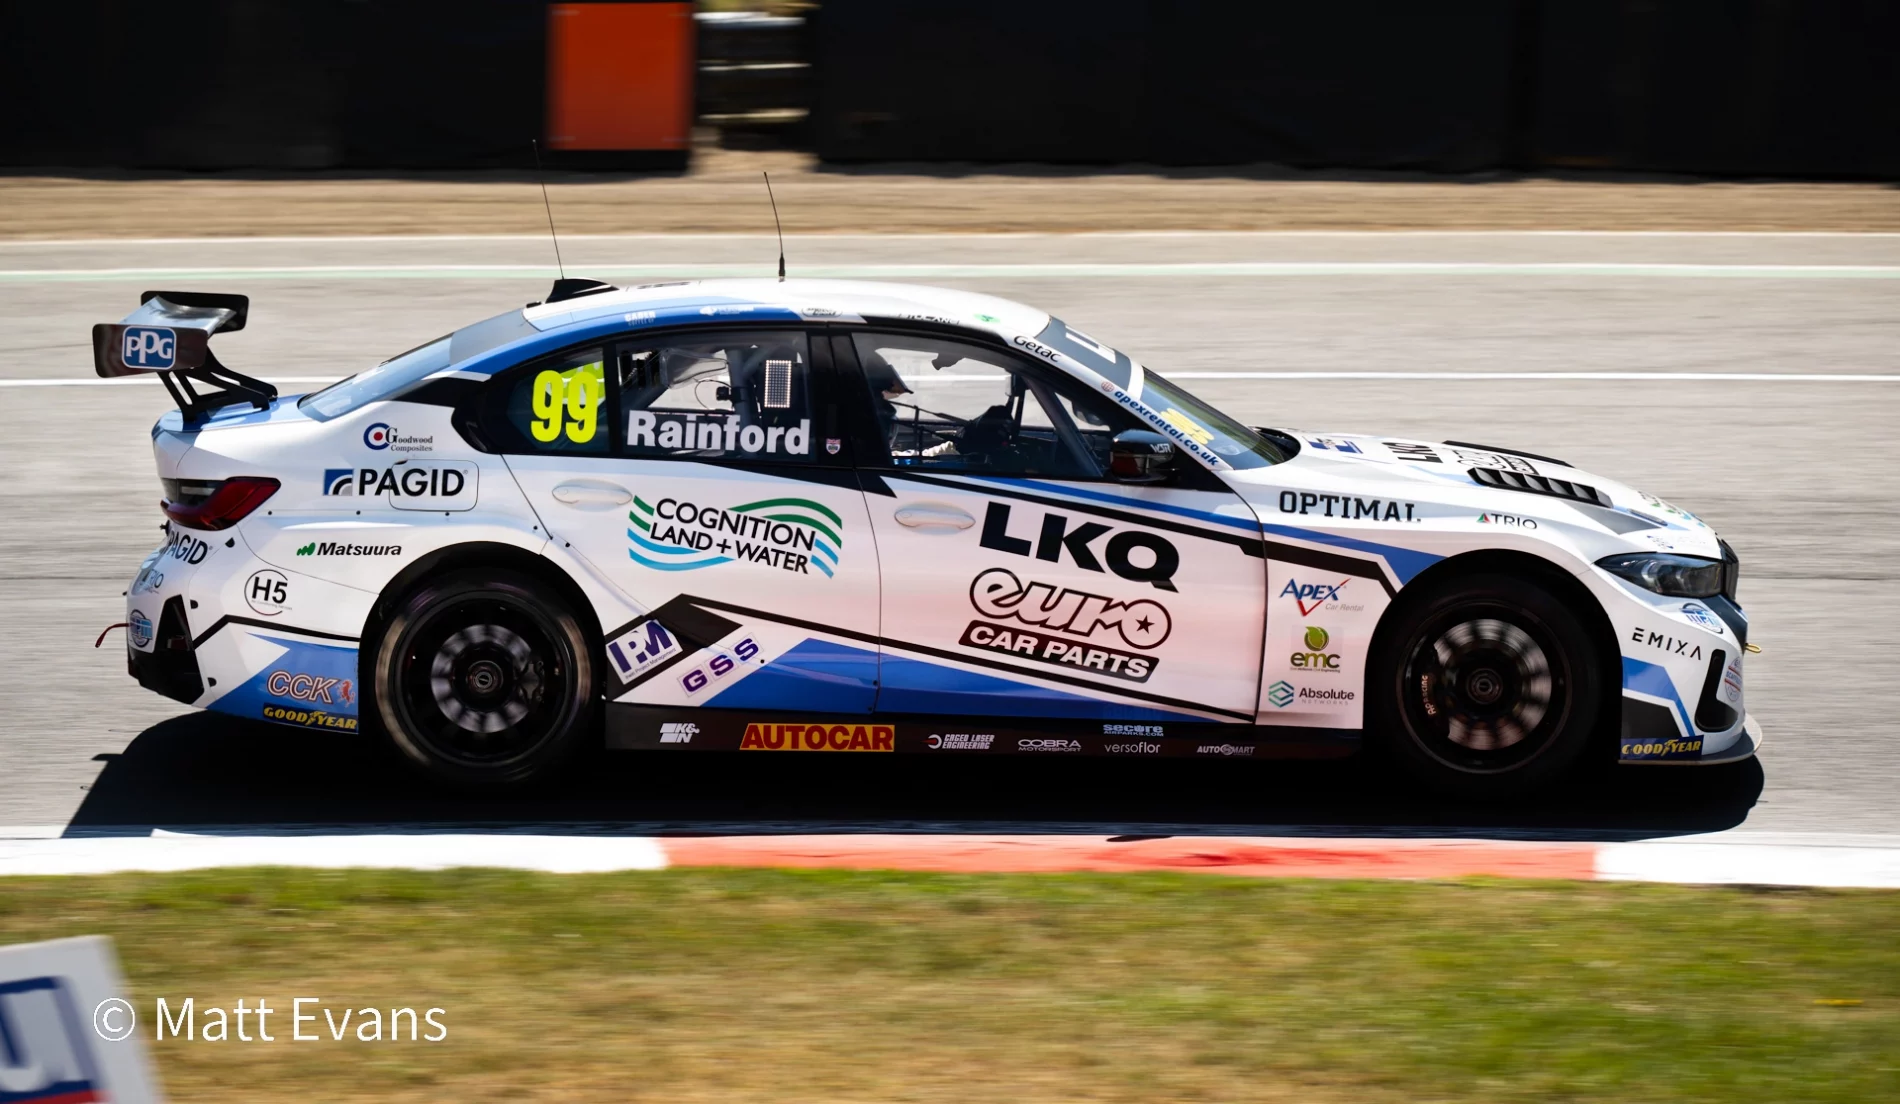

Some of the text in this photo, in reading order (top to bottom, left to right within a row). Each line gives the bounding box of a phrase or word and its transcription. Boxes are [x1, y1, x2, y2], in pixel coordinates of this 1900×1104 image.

[126, 331, 173, 364] PPG
[1013, 335, 1062, 363] Getac
[531, 370, 597, 443] 99
[385, 427, 433, 444] Goodwood
[627, 410, 811, 455] Rainford
[1114, 389, 1220, 467] apexrental.co.uk
[390, 444, 433, 453] Composites
[358, 468, 465, 497] PAGID
[656, 498, 816, 551] COGNITION
[1490, 513, 1538, 530] TRIO
[317, 542, 402, 556] Matsuura
[650, 522, 713, 550] LAND
[735, 540, 809, 574] WATER
[979, 501, 1180, 593] LKQ
[251, 576, 288, 604] H5
[969, 567, 1172, 650] euro
[1325, 602, 1364, 612] Car Rental
[650, 648, 677, 665] Management
[969, 626, 1150, 678] CAR PARTS
[1631, 627, 1702, 661] EMIXA
[1290, 652, 1341, 669] emc
[267, 670, 338, 704] CCK
[1299, 687, 1354, 700] Absolute
[263, 706, 358, 730] GOODYEAR
[1103, 724, 1163, 733] secure
[741, 724, 893, 750] AUTOCAR
[942, 741, 990, 749] ENGINEERING
[944, 734, 969, 742] CAGED
[1018, 739, 1081, 748] COBRA
[1104, 742, 1160, 753] versoflor
